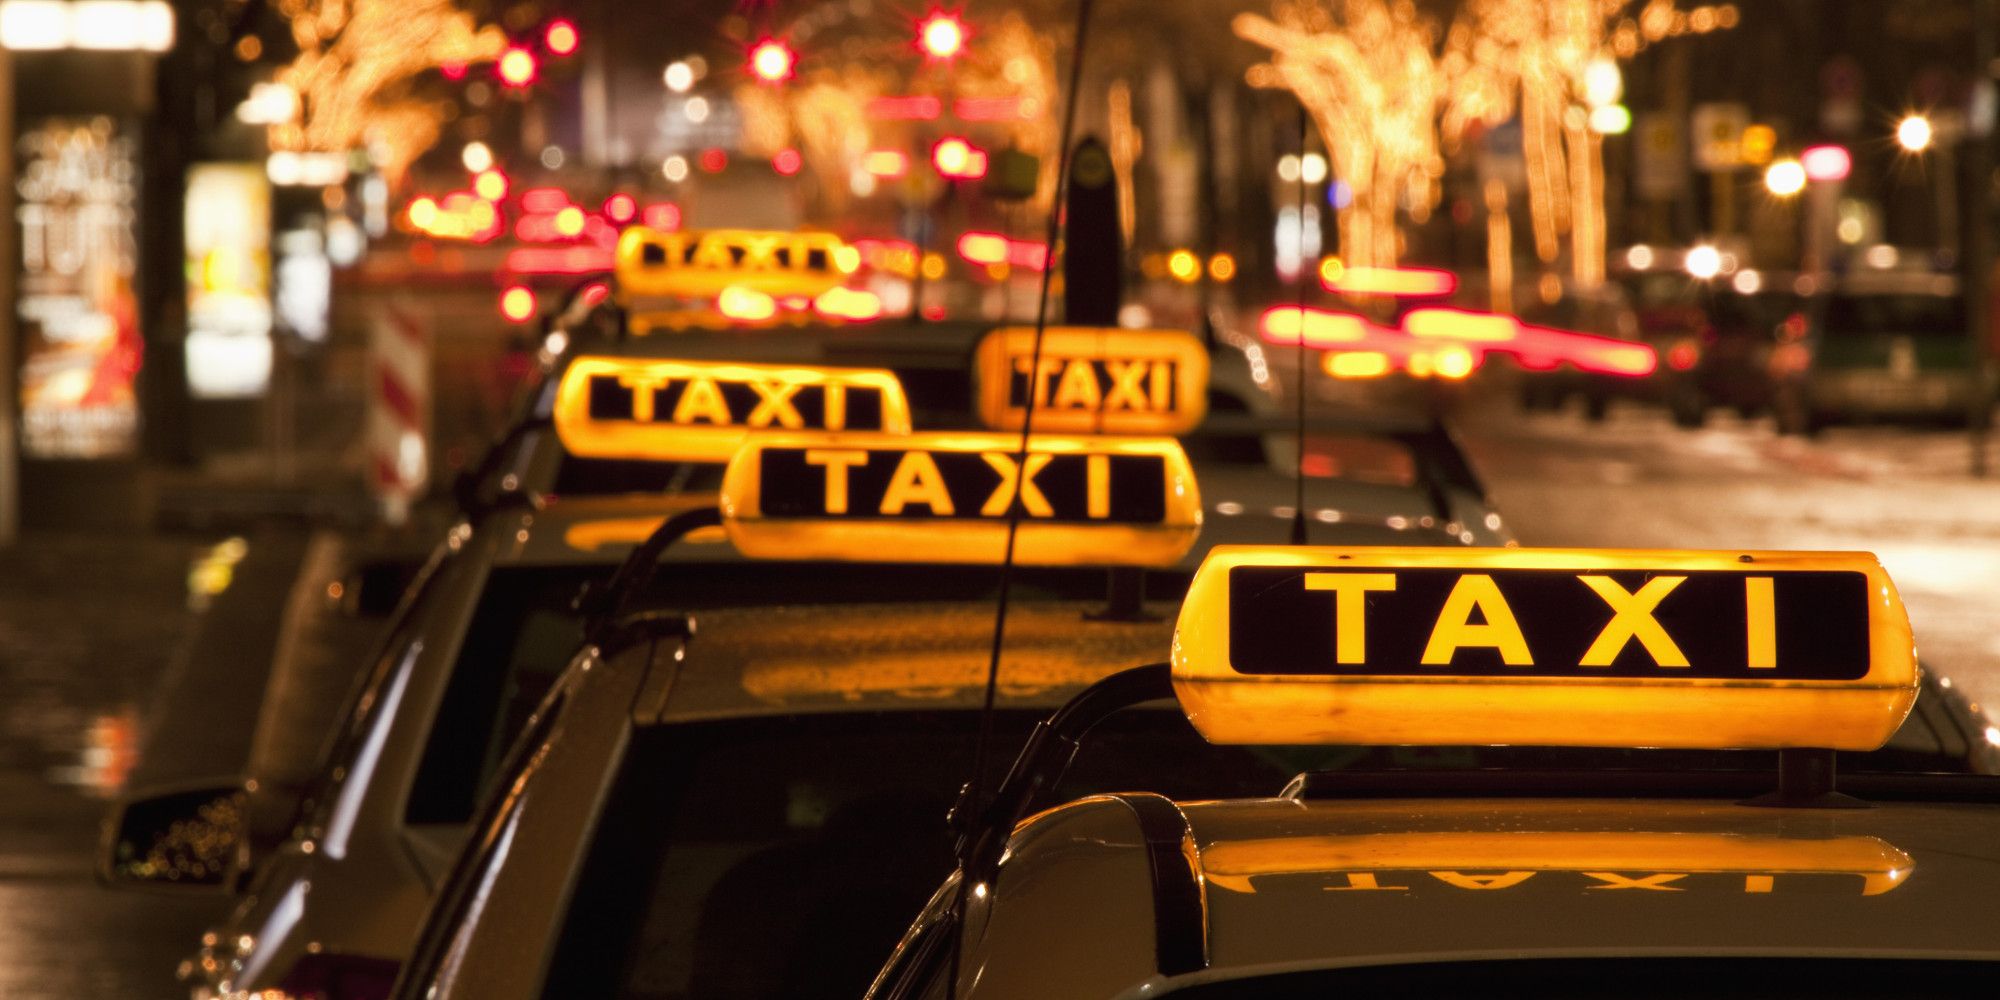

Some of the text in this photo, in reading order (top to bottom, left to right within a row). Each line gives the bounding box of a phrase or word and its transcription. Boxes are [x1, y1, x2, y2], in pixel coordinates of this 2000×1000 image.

[656, 236, 810, 269] TAXI
[618, 371, 846, 430] TAXI
[1015, 357, 1171, 411] TAXI
[805, 450, 1110, 518] TAXI
[1305, 573, 1776, 668] TAXI
